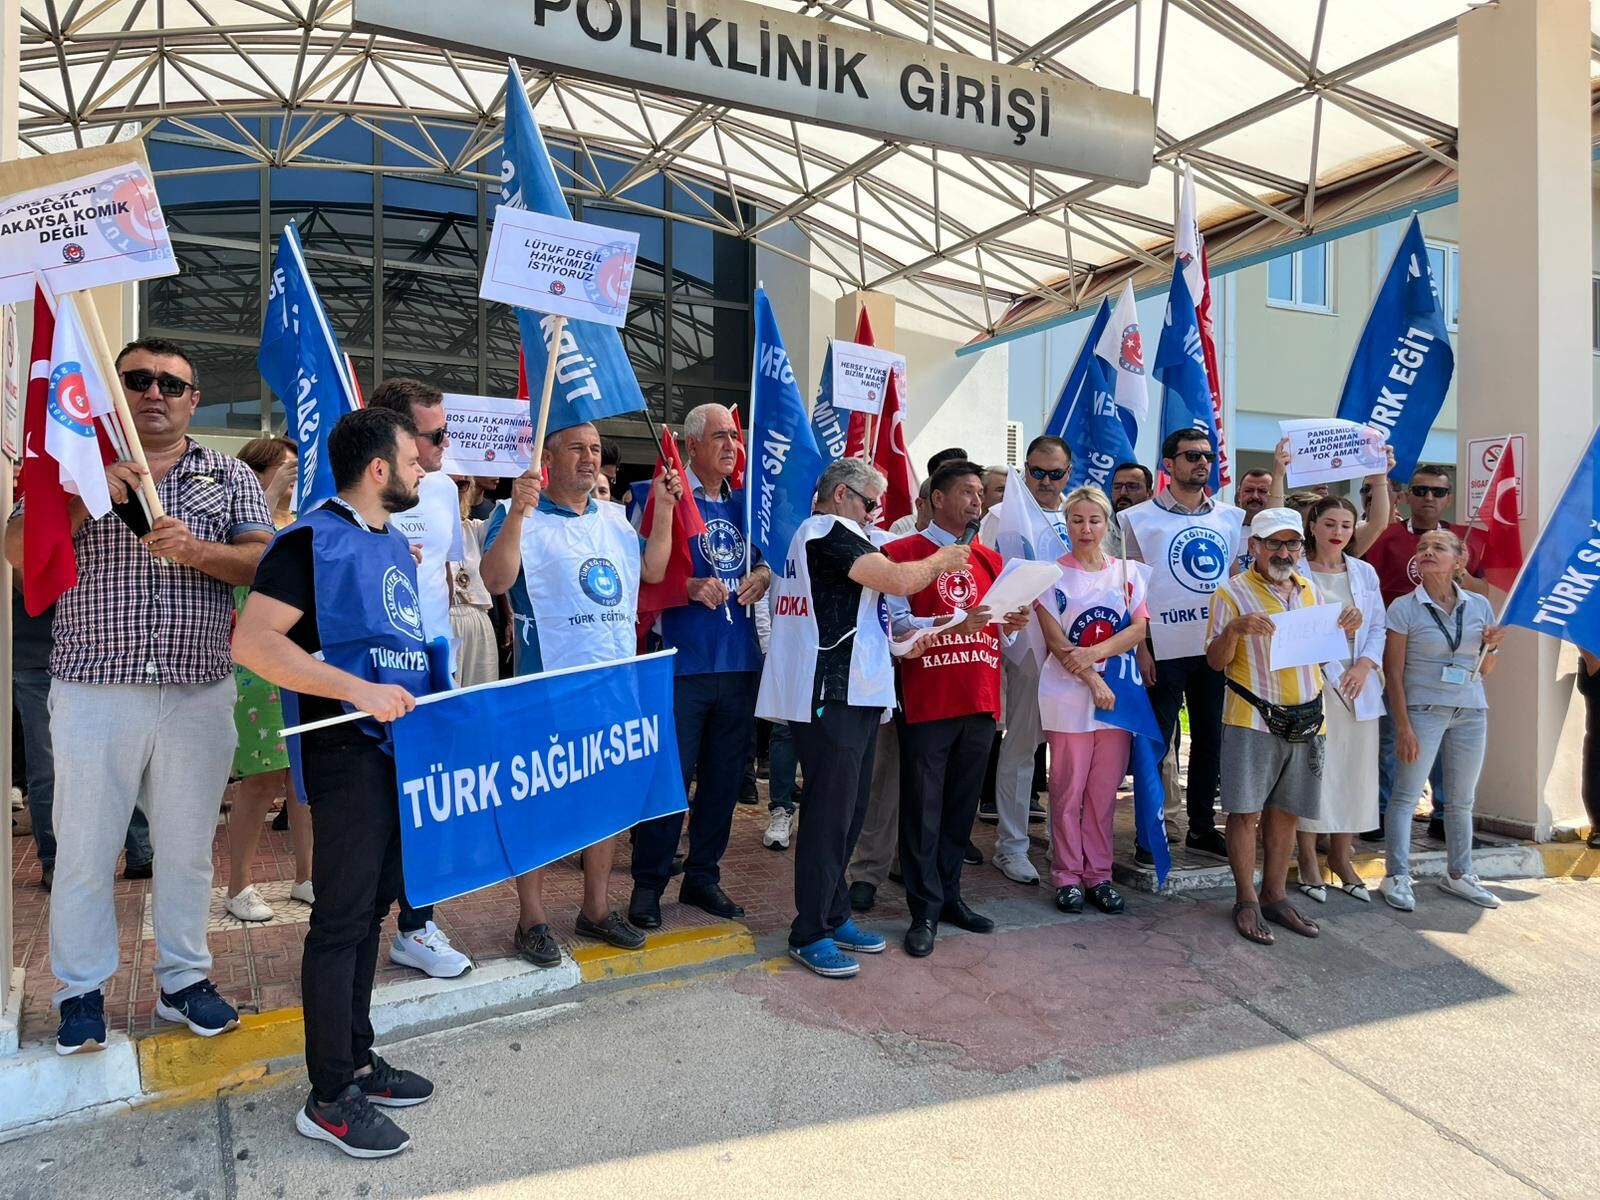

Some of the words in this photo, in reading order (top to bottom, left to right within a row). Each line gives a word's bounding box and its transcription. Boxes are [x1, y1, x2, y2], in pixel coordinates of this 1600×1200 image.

[534, 0, 869, 99] POLİKLİNİK
[900, 61, 1050, 145] GİRİŞİ
[59, 187, 96, 201] ZAM
[29, 200, 79, 216] DEĞİL
[74, 201, 130, 222] KOMİK
[40, 224, 88, 243] DEĞİL
[524, 239, 564, 254] LÜTUF
[566, 247, 603, 263] DEĞİL
[530, 250, 595, 272] HAKKIMIZI
[528, 260, 594, 282] İSTİYORUZ
[841, 361, 867, 372] HERŞEY
[845, 369, 864, 379] BİZİM
[861, 380, 880, 390] HARİÇ
[446, 414, 465, 424] BOŞ
[467, 416, 489, 424] LAFA
[482, 425, 499, 433] TOK
[460, 441, 490, 449] TEKLİF
[493, 443, 518, 451] YAPIN
[480, 433, 517, 443] DÜZGÜN
[518, 435, 533, 444] BİR
[1298, 445, 1317, 455] ZAM
[1320, 438, 1371, 451] DÖNEMİNDE
[1309, 433, 1358, 446] KAHRAMAN
[1312, 452, 1331, 460] YOK
[1333, 448, 1360, 458] AMAN
[758, 475, 776, 547] TÜRK
[1171, 541, 1184, 566] TÜRK
[1184, 531, 1215, 541] EĞİTİM
[1532, 565, 1600, 626] TÜRK
[568, 613, 595, 626] TÜRK
[1078, 608, 1119, 629] SAĞLIK
[1160, 608, 1197, 625] TÜRK
[403, 761, 502, 829] TÜRK
[511, 715, 659, 801] SAĞLIK-SEN
